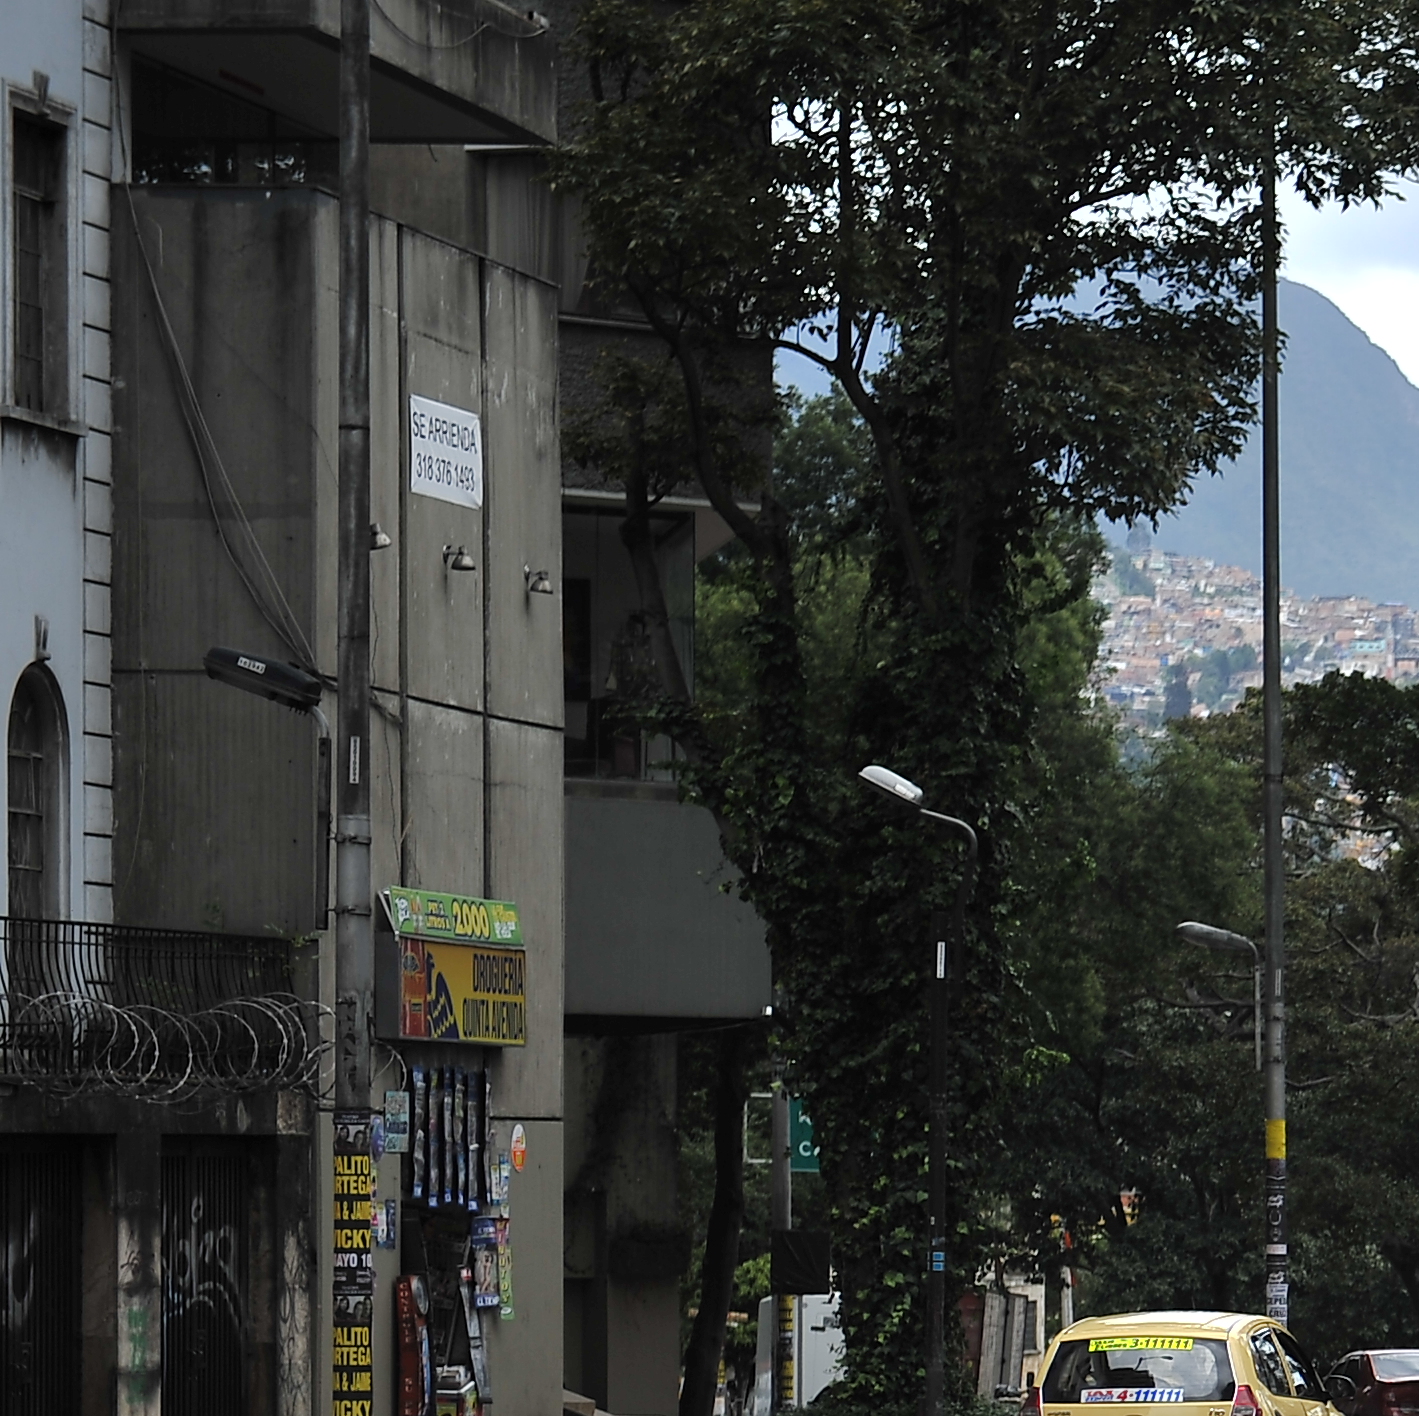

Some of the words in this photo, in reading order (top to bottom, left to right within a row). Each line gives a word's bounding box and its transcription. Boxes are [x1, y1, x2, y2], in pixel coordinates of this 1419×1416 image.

[413, 411, 426, 439] SE
[428, 416, 477, 455] ARRIENDA
[416, 452, 434, 481] 318
[435, 457, 452, 486] 376
